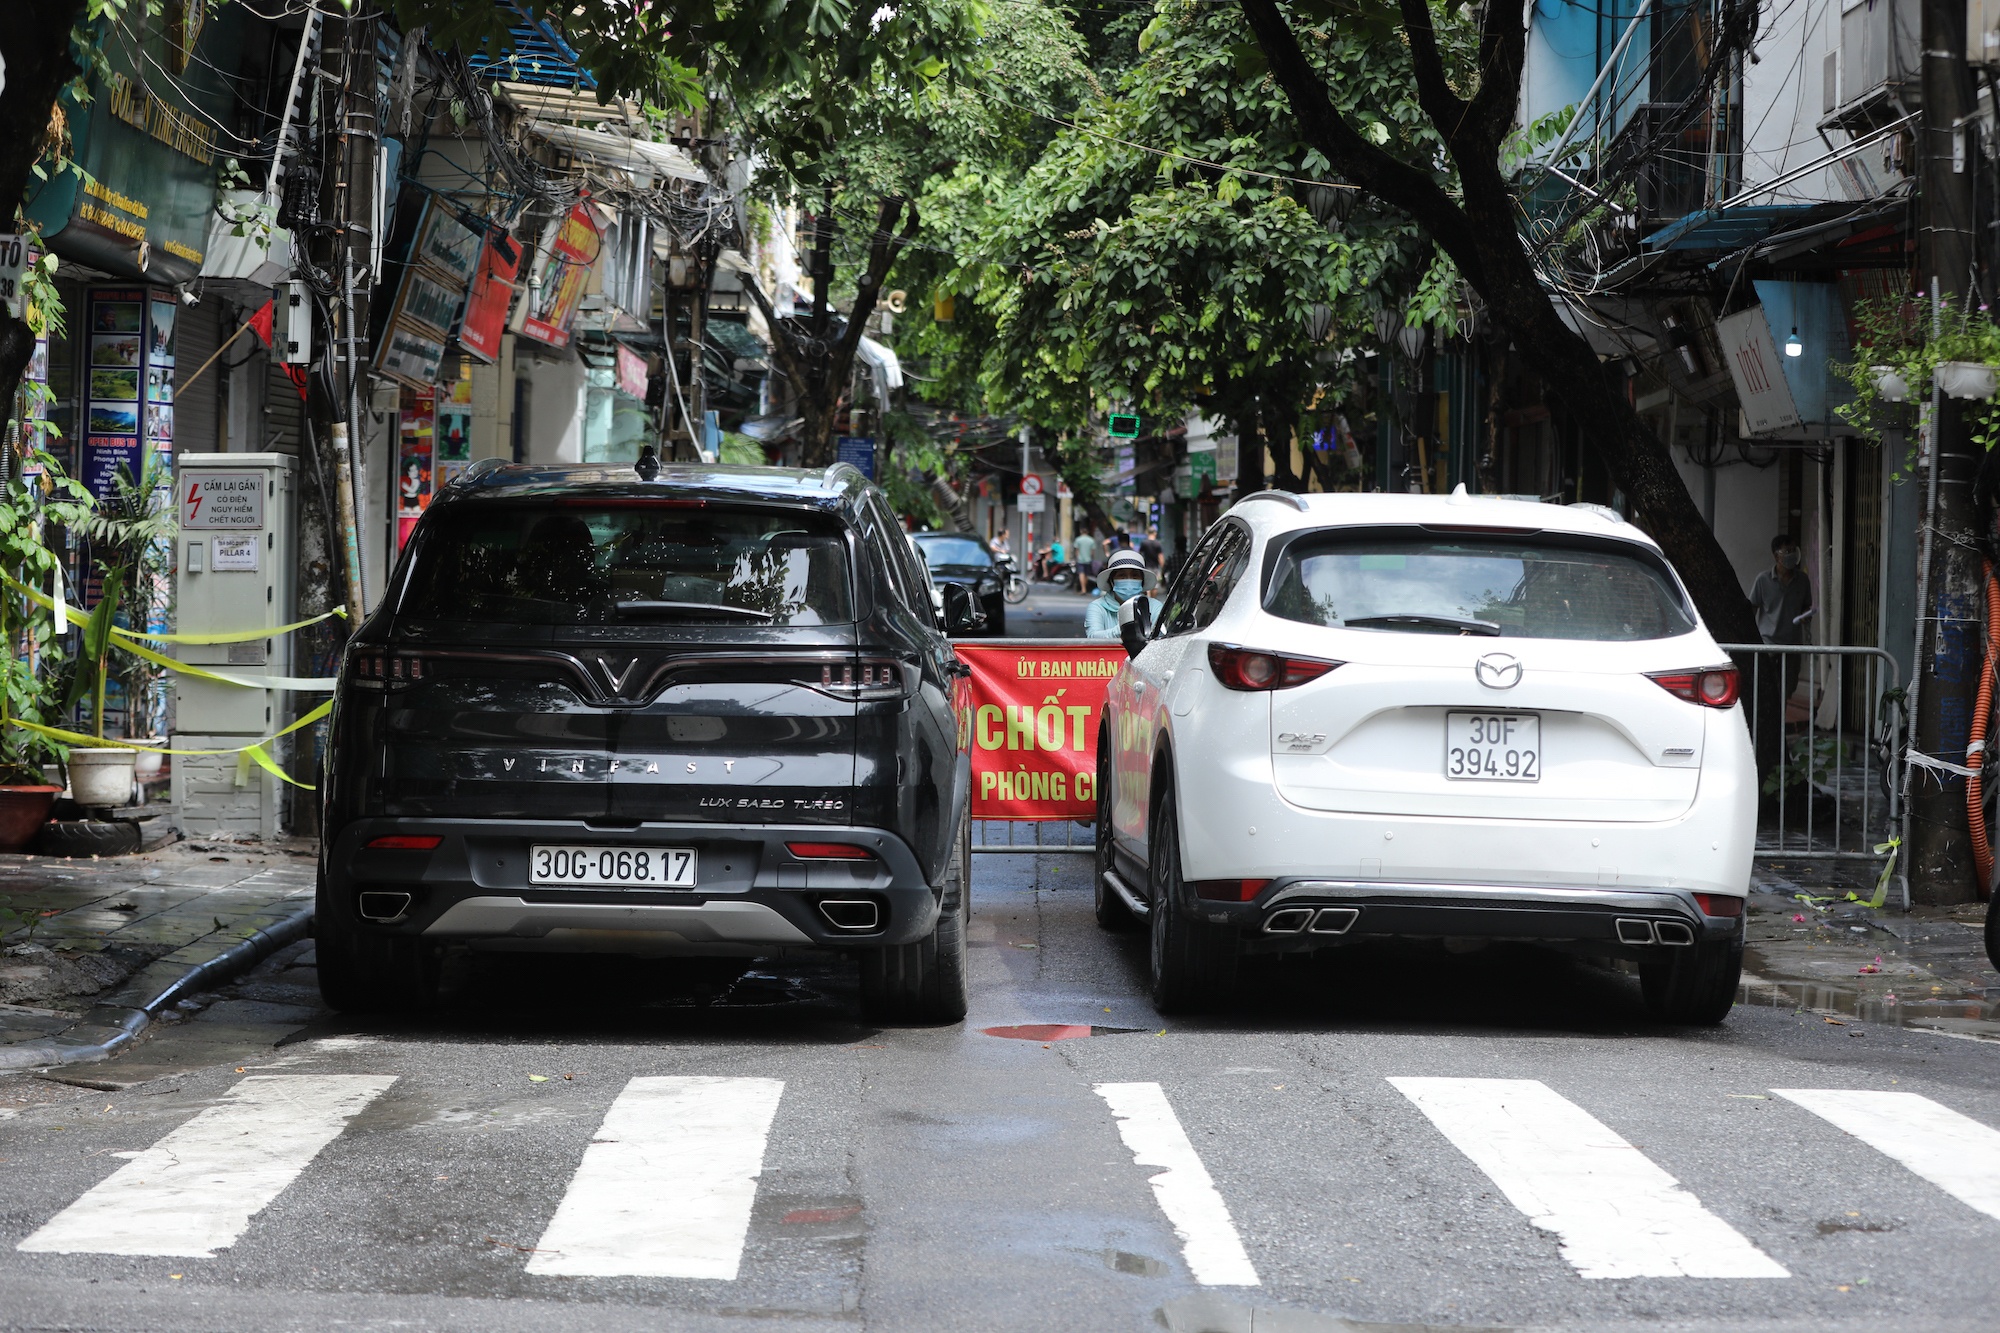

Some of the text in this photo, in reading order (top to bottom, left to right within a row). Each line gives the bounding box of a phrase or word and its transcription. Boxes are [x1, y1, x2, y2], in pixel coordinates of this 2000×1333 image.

[175, 111, 210, 164] HOSTEL
[1, 278, 15, 298] 38
[88, 437, 109, 446] OPEN
[110, 438, 126, 447] BUS
[126, 438, 137, 448] TO
[204, 479, 222, 491] CẤM
[223, 482, 237, 493] LẠI
[229, 495, 248, 505] ĐIỆN
[234, 503, 253, 513] HIỂM
[208, 514, 229, 524] CHẾT
[1018, 656, 1118, 677] ỦY BAN NHÂN
[976, 689, 1092, 752] CHỐT
[1278, 732, 1327, 744] CX-5
[1470, 716, 1518, 745] 30F
[503, 757, 736, 774] VINFAST
[1450, 747, 1536, 778] 394.92
[981, 764, 1066, 801] PHÒNG
[699, 797, 732, 808] LUX
[793, 800, 844, 810] TURBO
[536, 848, 692, 884] 30G-068.17
